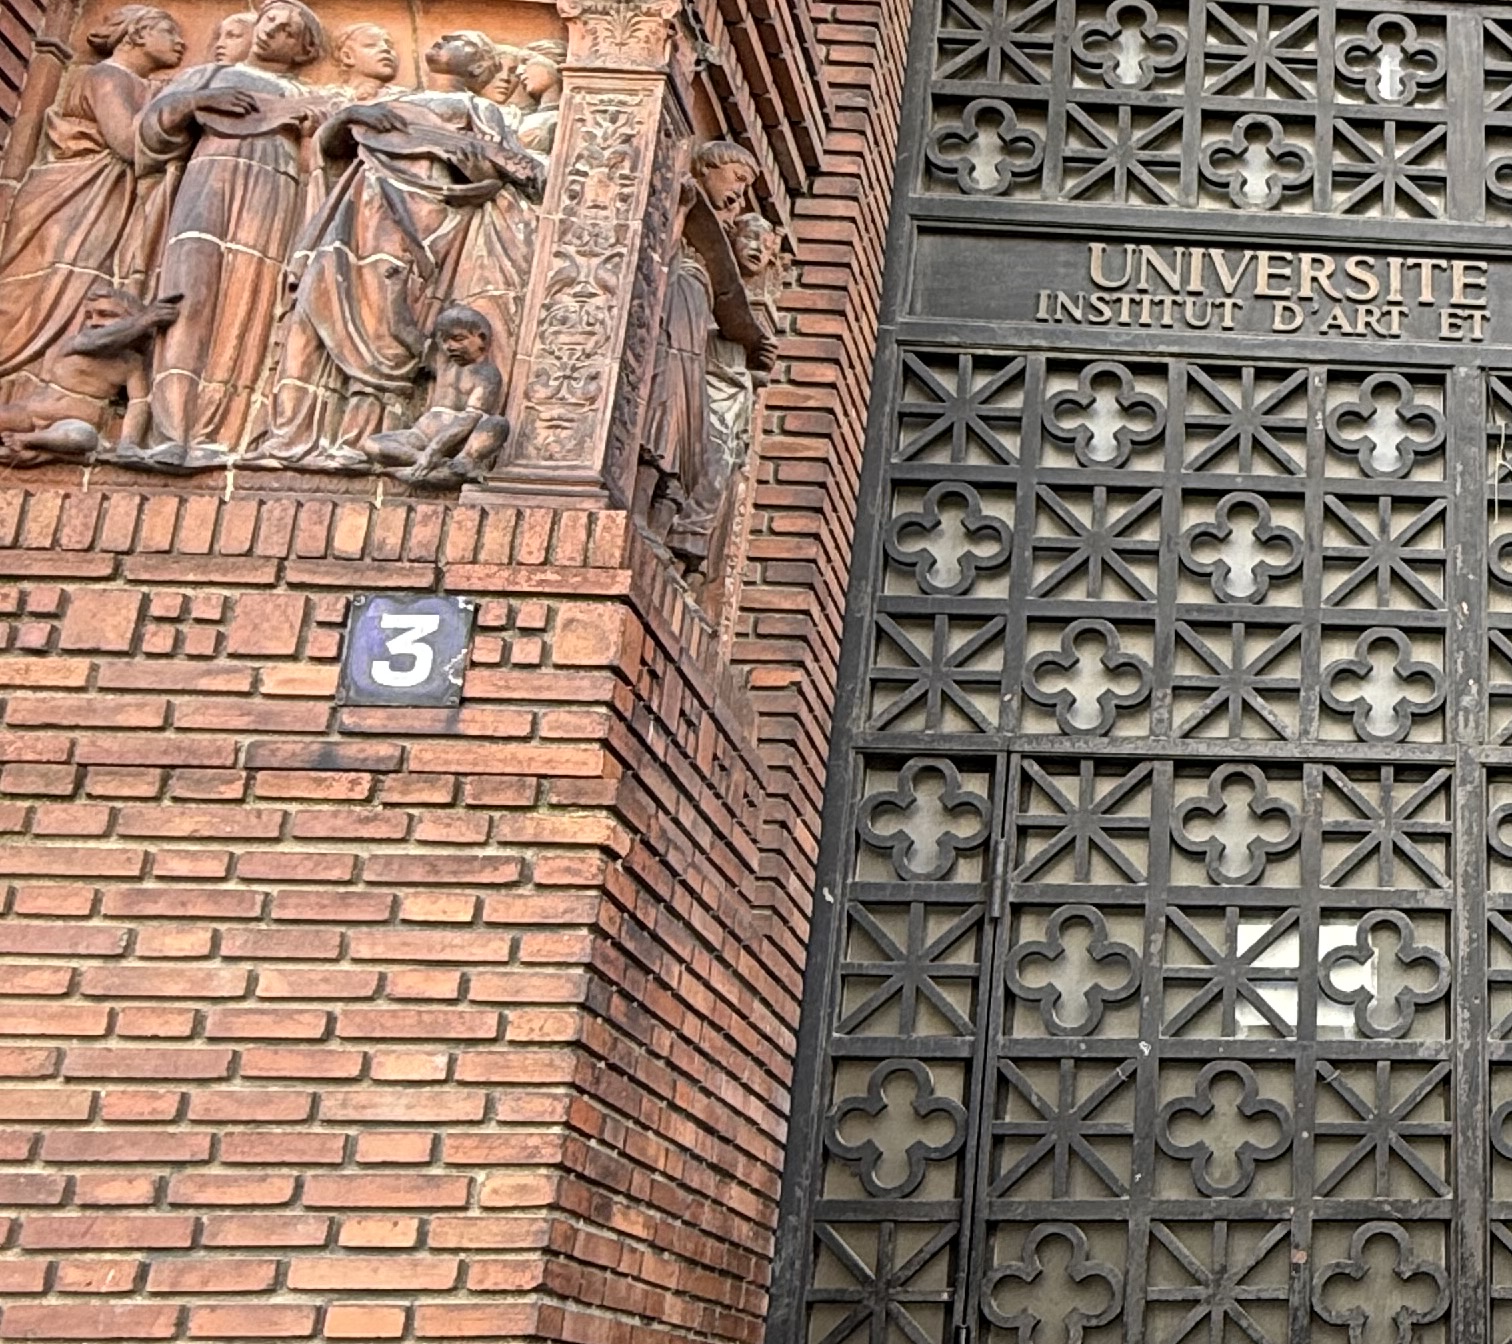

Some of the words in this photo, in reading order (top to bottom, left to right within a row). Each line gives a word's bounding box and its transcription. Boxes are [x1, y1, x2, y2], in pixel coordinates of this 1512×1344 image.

[1088, 242, 1488, 306] UNIVERSITE
[1036, 288, 1244, 331] INSTITUT
[1272, 297, 1409, 339] D'ART
[1438, 308, 1490, 342] ET
[371, 613, 440, 687] 3
